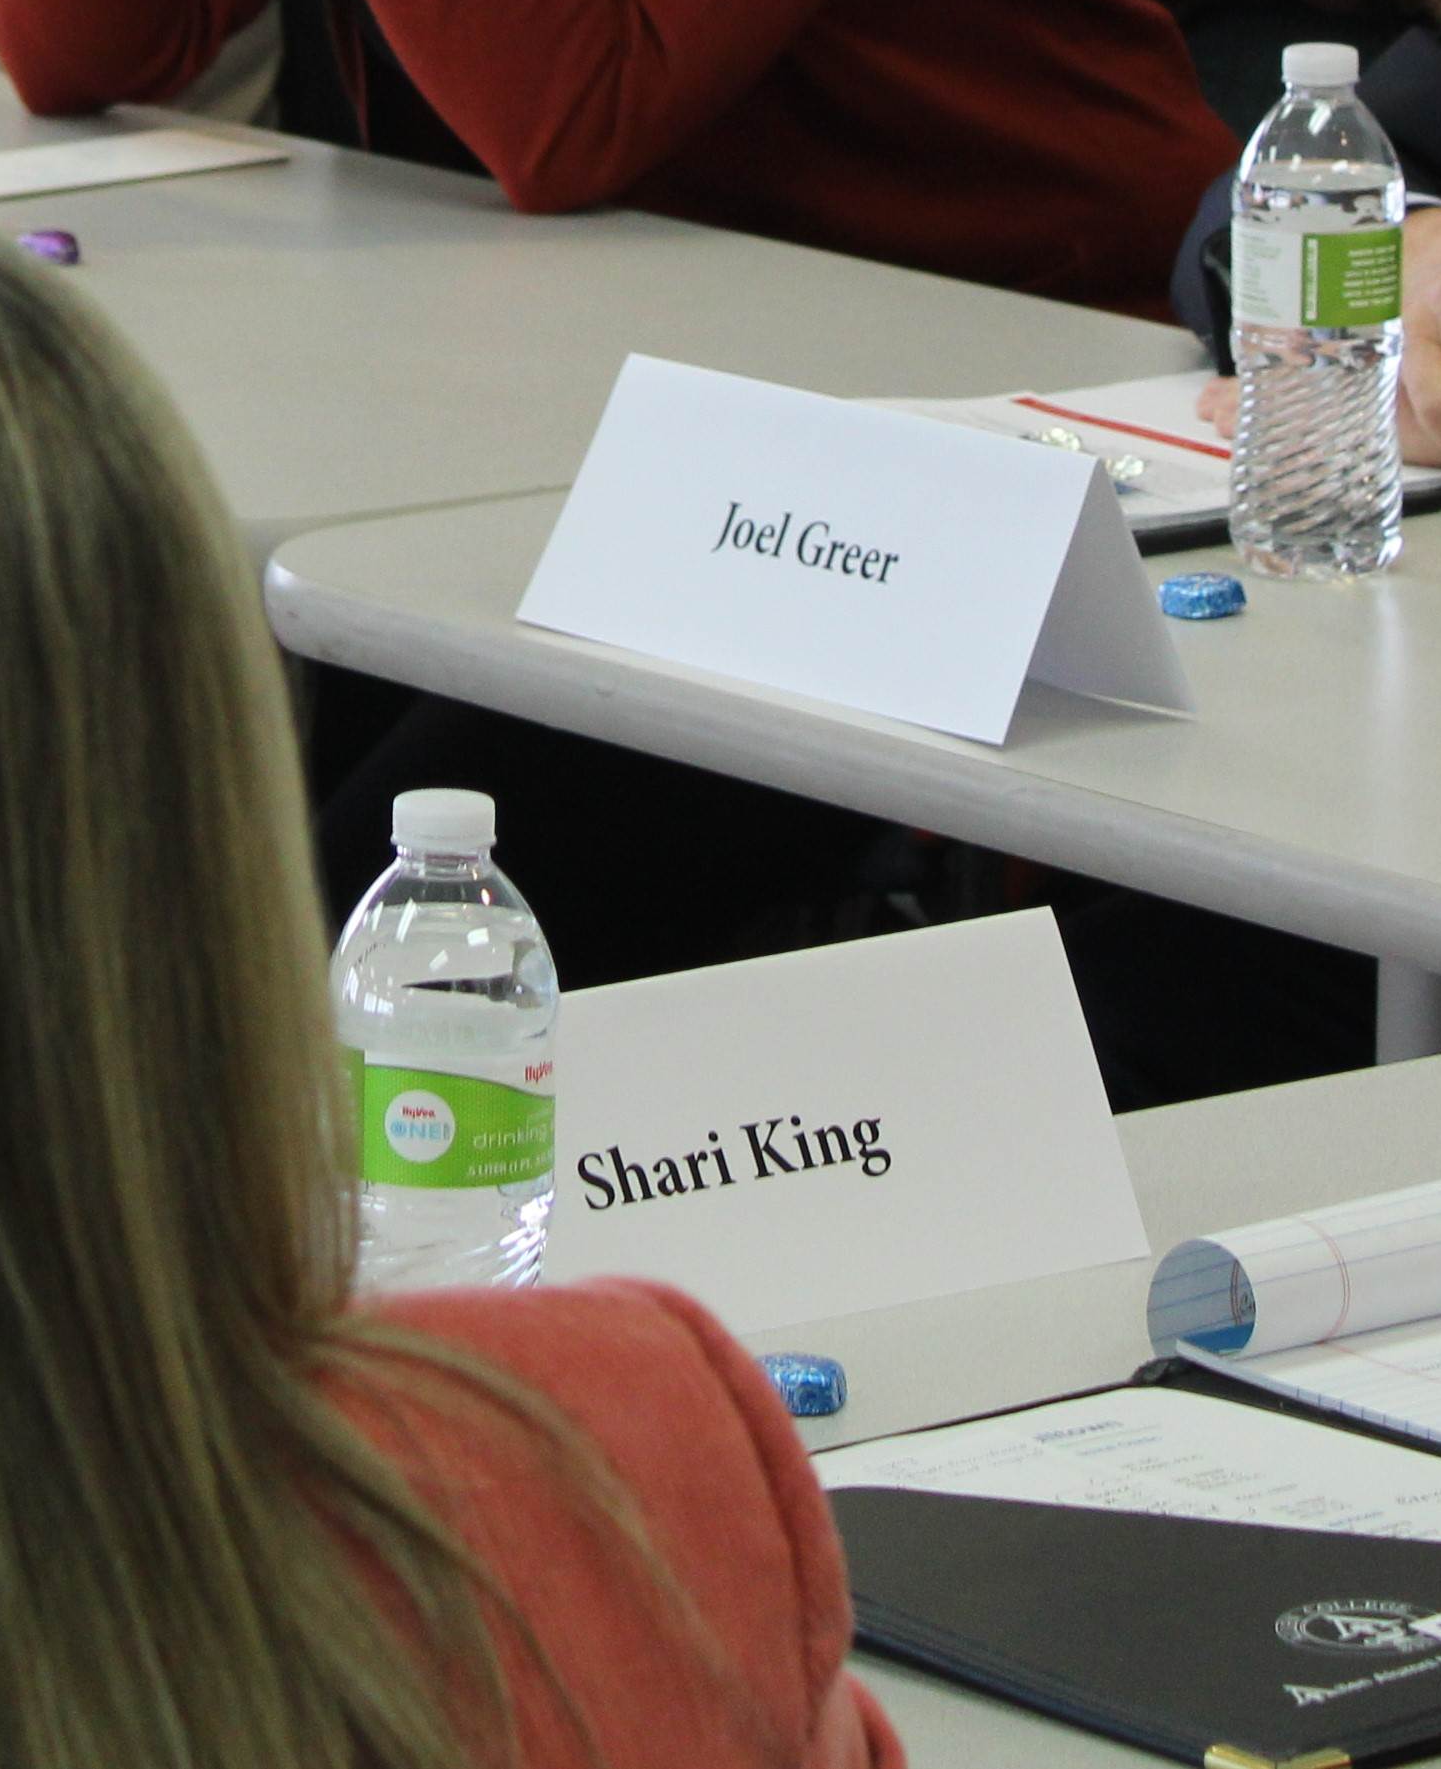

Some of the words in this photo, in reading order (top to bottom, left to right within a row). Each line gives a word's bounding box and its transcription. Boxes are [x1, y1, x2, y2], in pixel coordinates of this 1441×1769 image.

[712, 501, 792, 558] Joel
[797, 520, 900, 584] Greer
[577, 1130, 737, 1210] Shari
[740, 1114, 892, 1177] King
